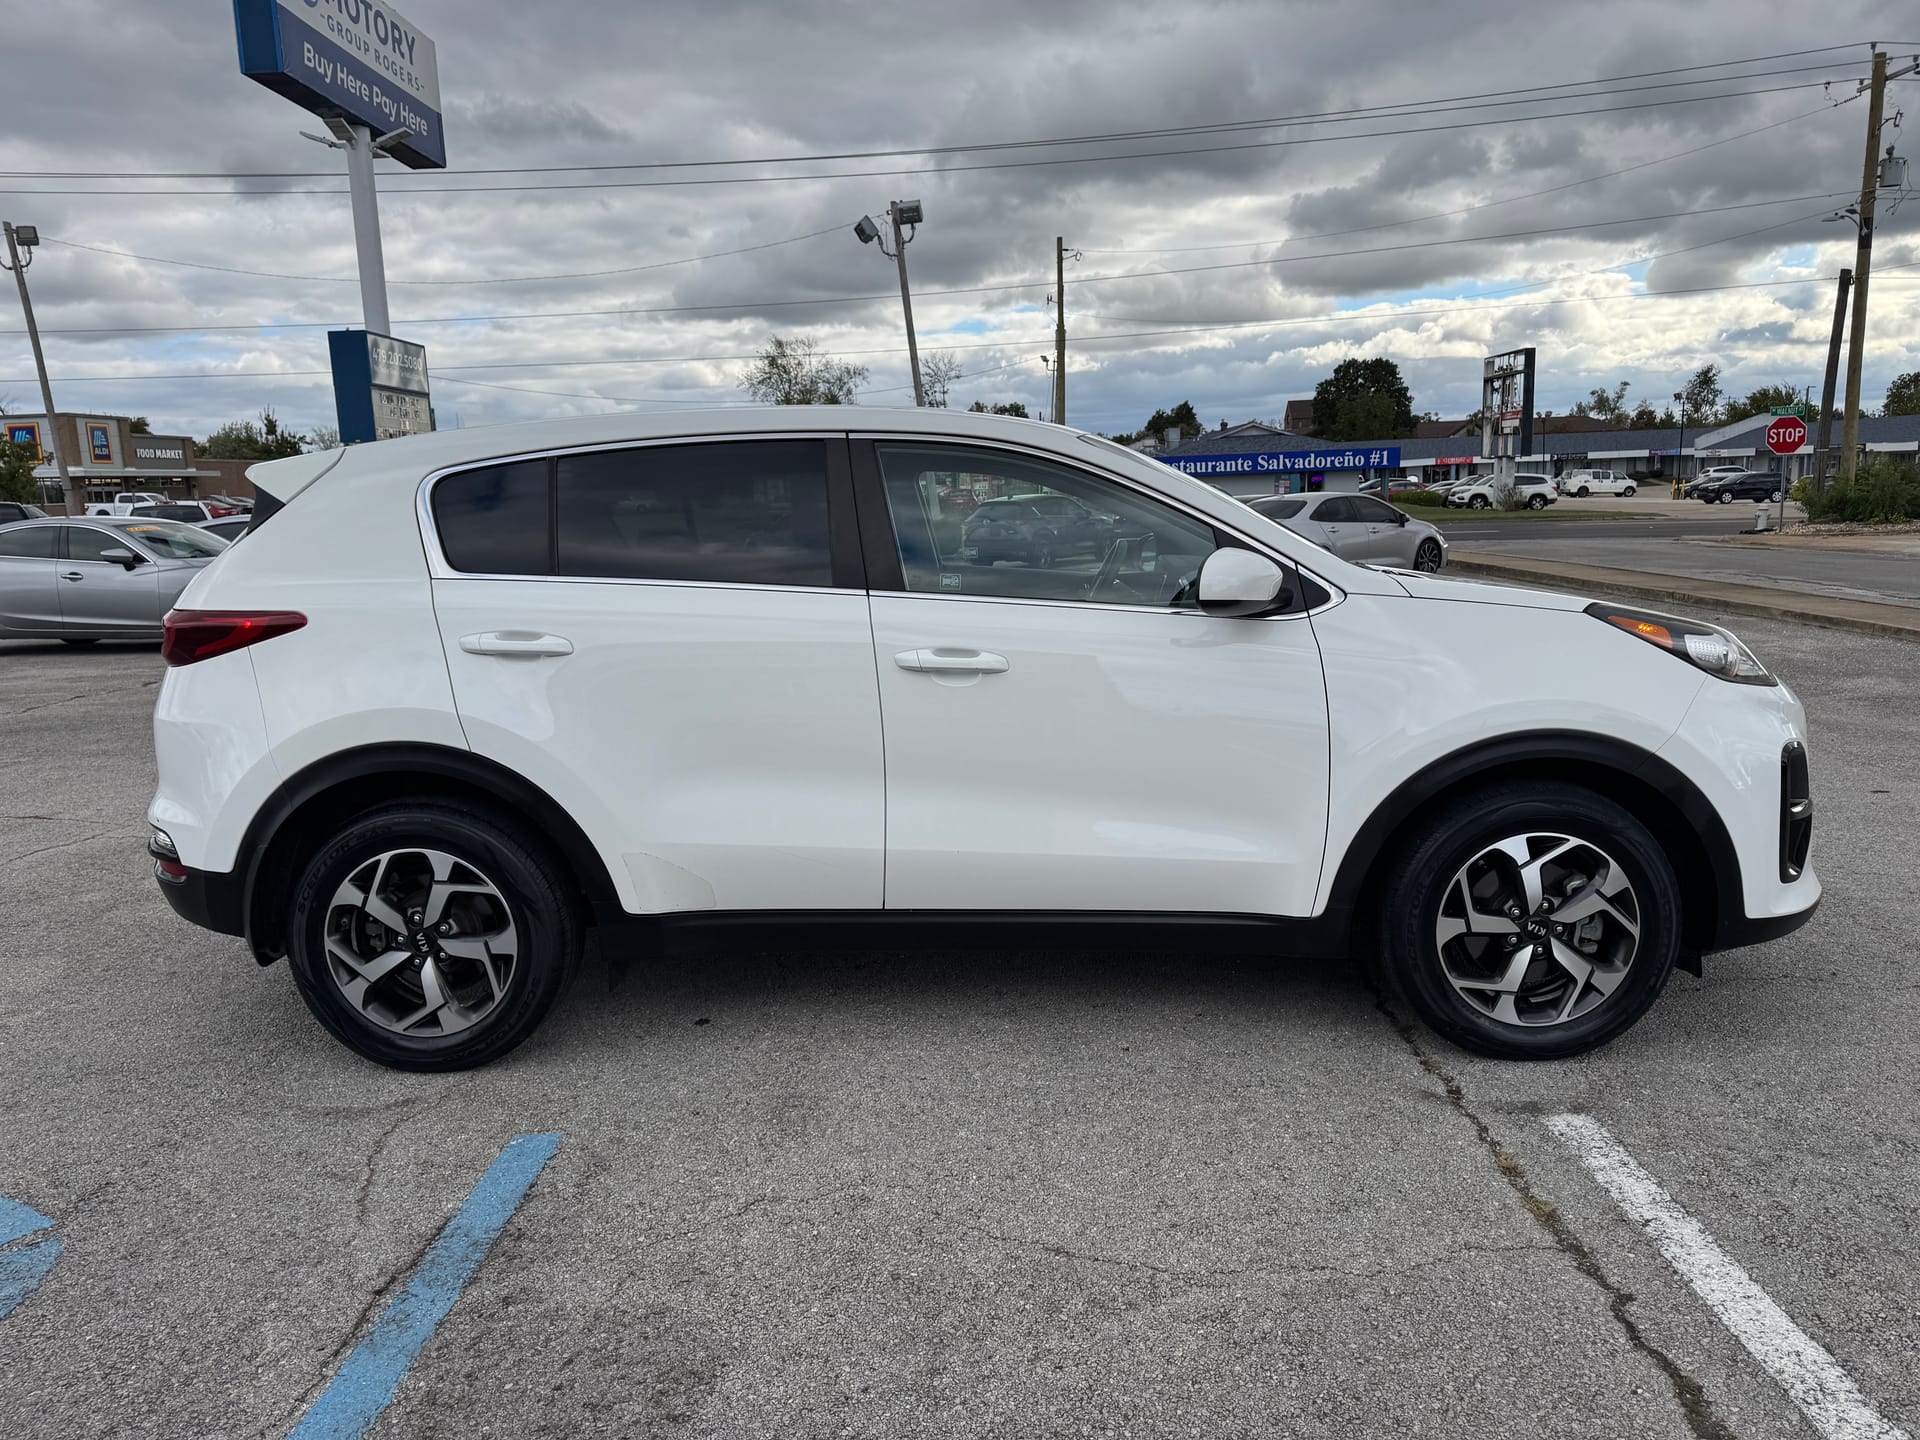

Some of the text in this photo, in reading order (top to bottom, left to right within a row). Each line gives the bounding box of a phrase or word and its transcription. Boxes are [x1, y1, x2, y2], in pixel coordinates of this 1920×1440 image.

[303, 41, 428, 136] Buy Here Pay Here
[1768, 428, 1804, 444] STOP
[94, 447, 109, 455] ALDI
[136, 448, 183, 460] FOOD MARKET
[1257, 451, 1365, 471] Salvadoreño
[1369, 450, 1389, 466] #1
[1527, 921, 1547, 937] KIA
[416, 931, 430, 952] KIA
